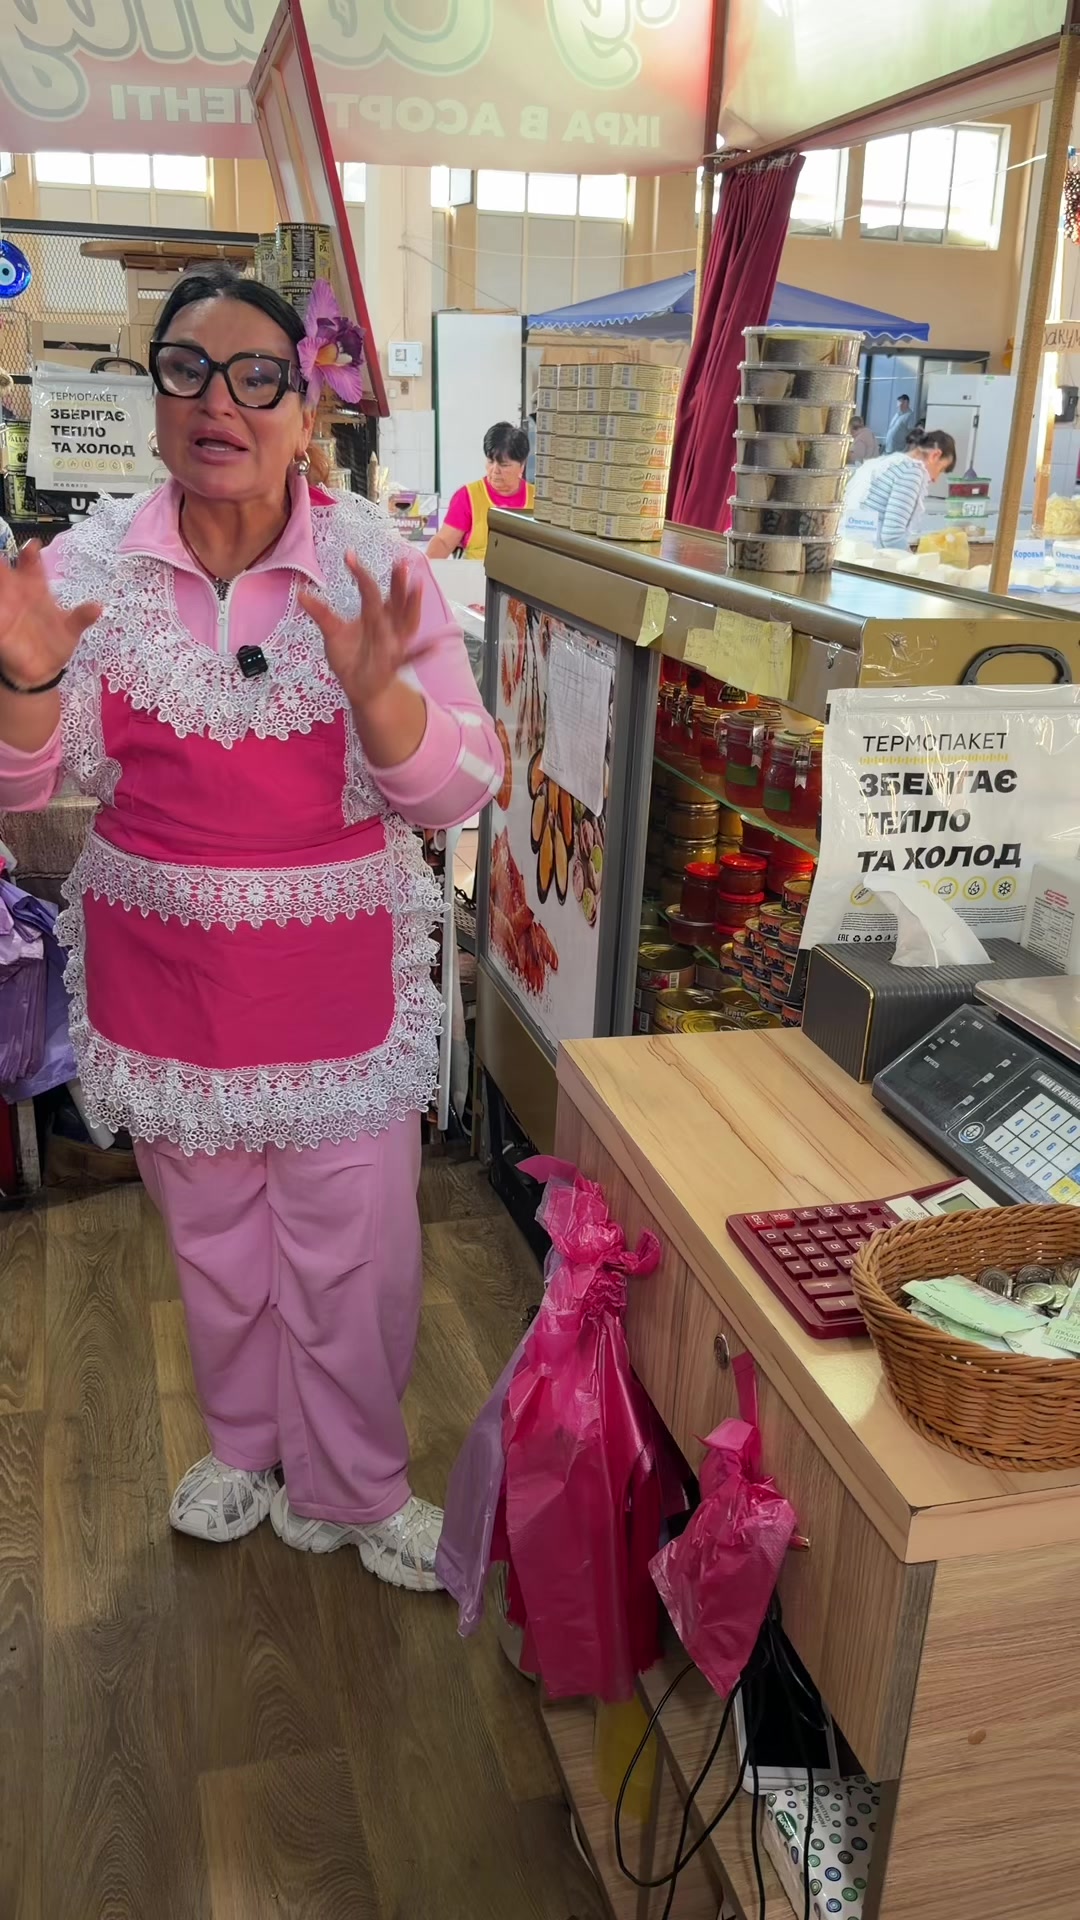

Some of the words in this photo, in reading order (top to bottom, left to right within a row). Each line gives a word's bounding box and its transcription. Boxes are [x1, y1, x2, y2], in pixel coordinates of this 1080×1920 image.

[50, 392, 118, 402] ТЕРМОПАКЕТ
[50, 408, 126, 421] ЗБЕРІГАЄ
[51, 425, 106, 438] ТЕПЛО
[52, 442, 72, 453] ТА
[76, 442, 136, 458] ХОЛОД
[1014, 550, 1044, 560] Коровья
[862, 732, 1008, 752] ТЕРМОПАКЕТ
[859, 808, 971, 836] ТЕПЛО
[857, 850, 896, 873] ТА
[902, 843, 1022, 871] ХОЛОД
[1034, 1101, 1044, 1110] 7
[1050, 1113, 1060, 1122] 8
[1067, 1125, 1077, 1134] 9
[1015, 1118, 1024, 1127] 4
[1029, 1129, 1040, 1138] 5
[1046, 1142, 1056, 1151] 6
[1009, 1146, 1019, 1155] 2
[1025, 1159, 1035, 1168] 3
[1042, 1172, 1052, 1180] 0
